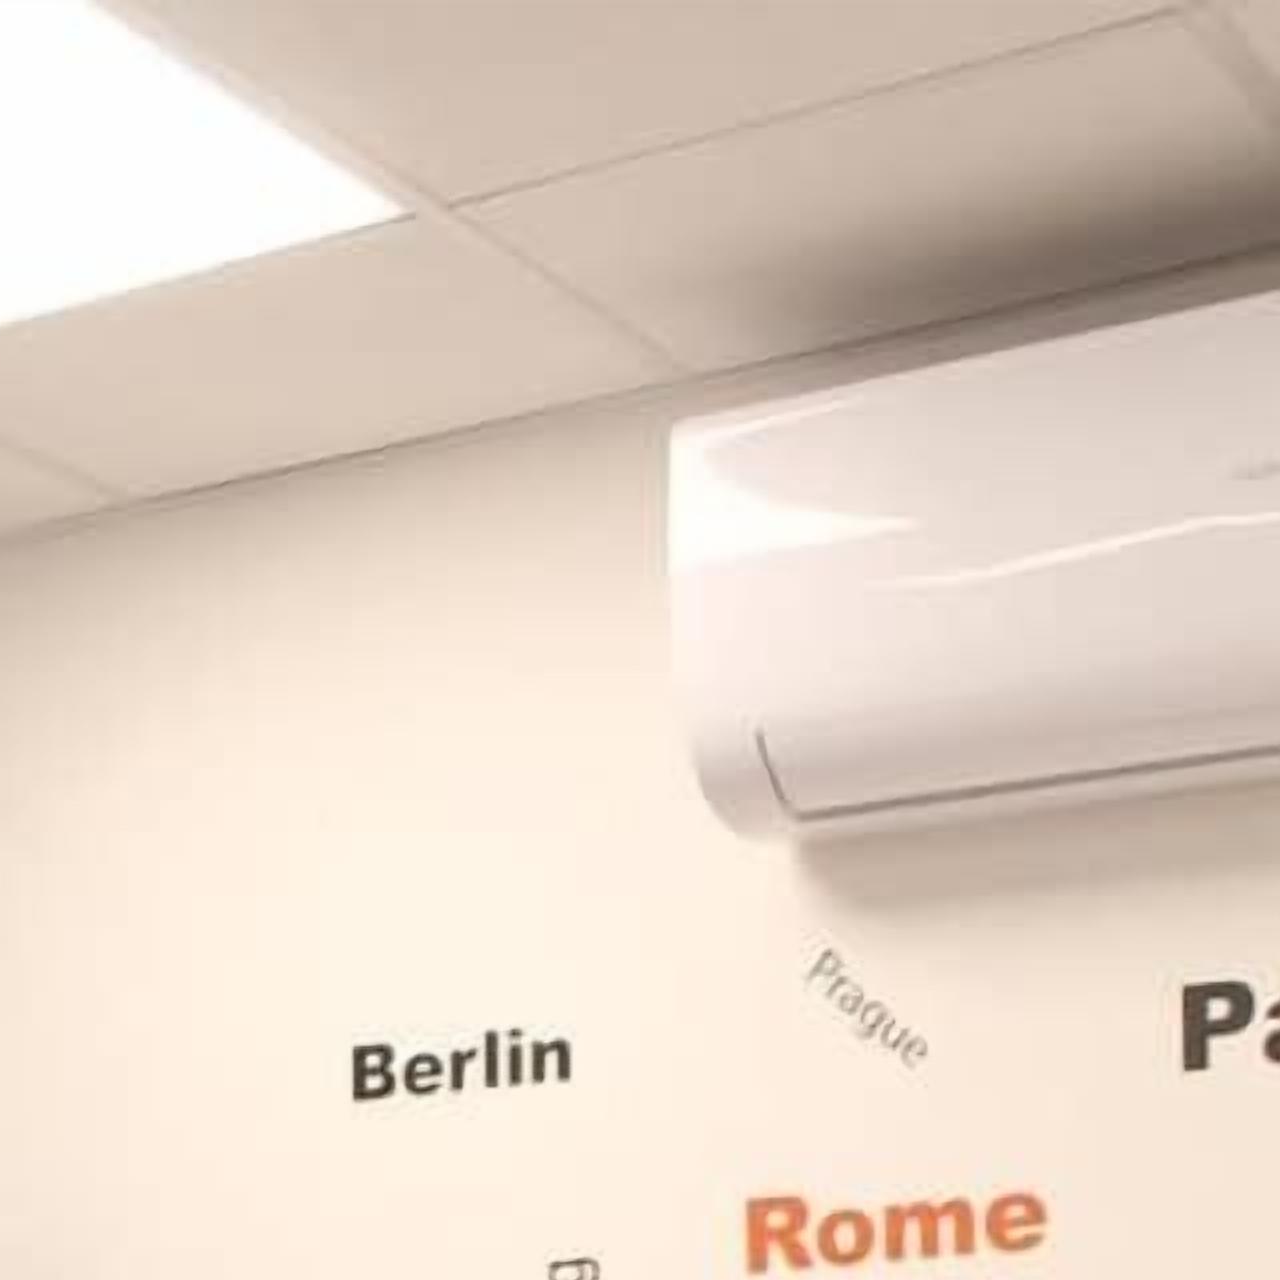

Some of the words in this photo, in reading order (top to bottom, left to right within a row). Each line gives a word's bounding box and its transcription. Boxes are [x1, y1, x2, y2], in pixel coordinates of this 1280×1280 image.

[805, 946, 930, 1069] Prague
[351, 1028, 572, 1103] Berlin
[745, 1191, 1048, 1276] Rome
